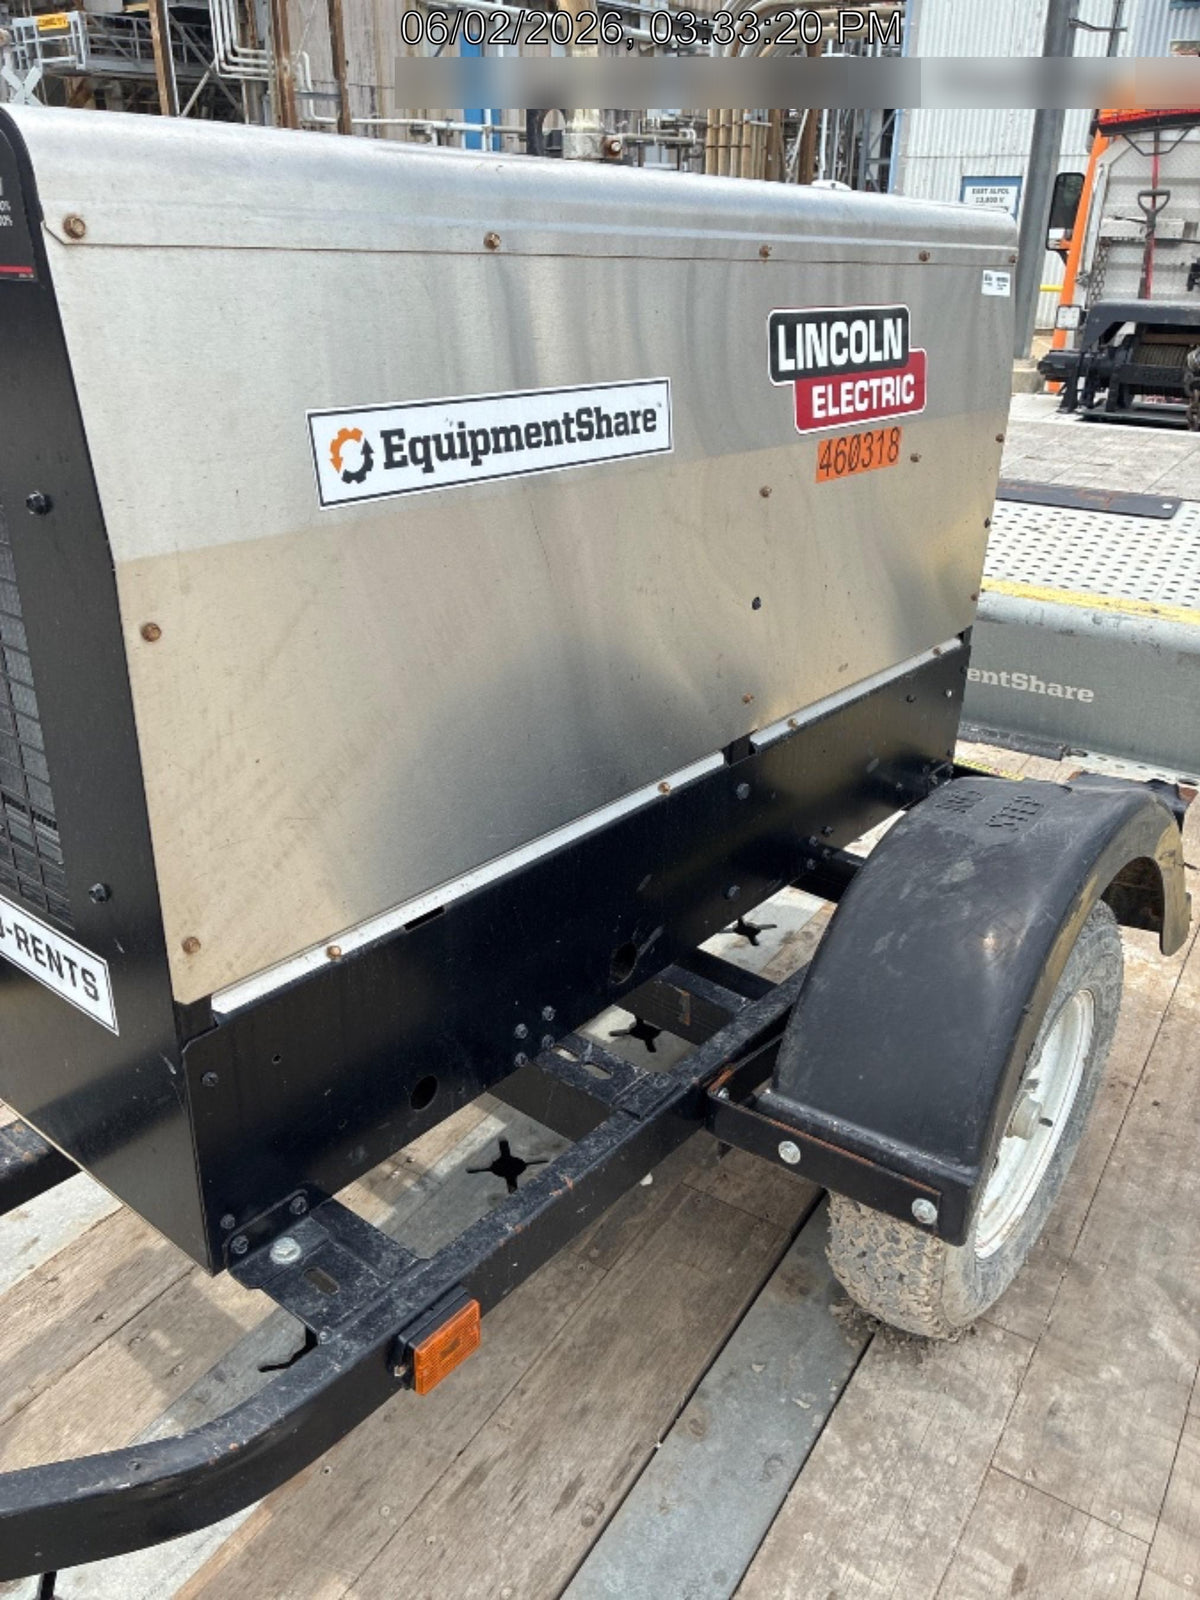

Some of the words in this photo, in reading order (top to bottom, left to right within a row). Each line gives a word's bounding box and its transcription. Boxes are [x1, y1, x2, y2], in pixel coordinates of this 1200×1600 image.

[778, 318, 902, 372] LINCOLN
[812, 373, 915, 419] ELECTRIC
[380, 407, 657, 474] EquipmentShare
[818, 427, 901, 477] 460318
